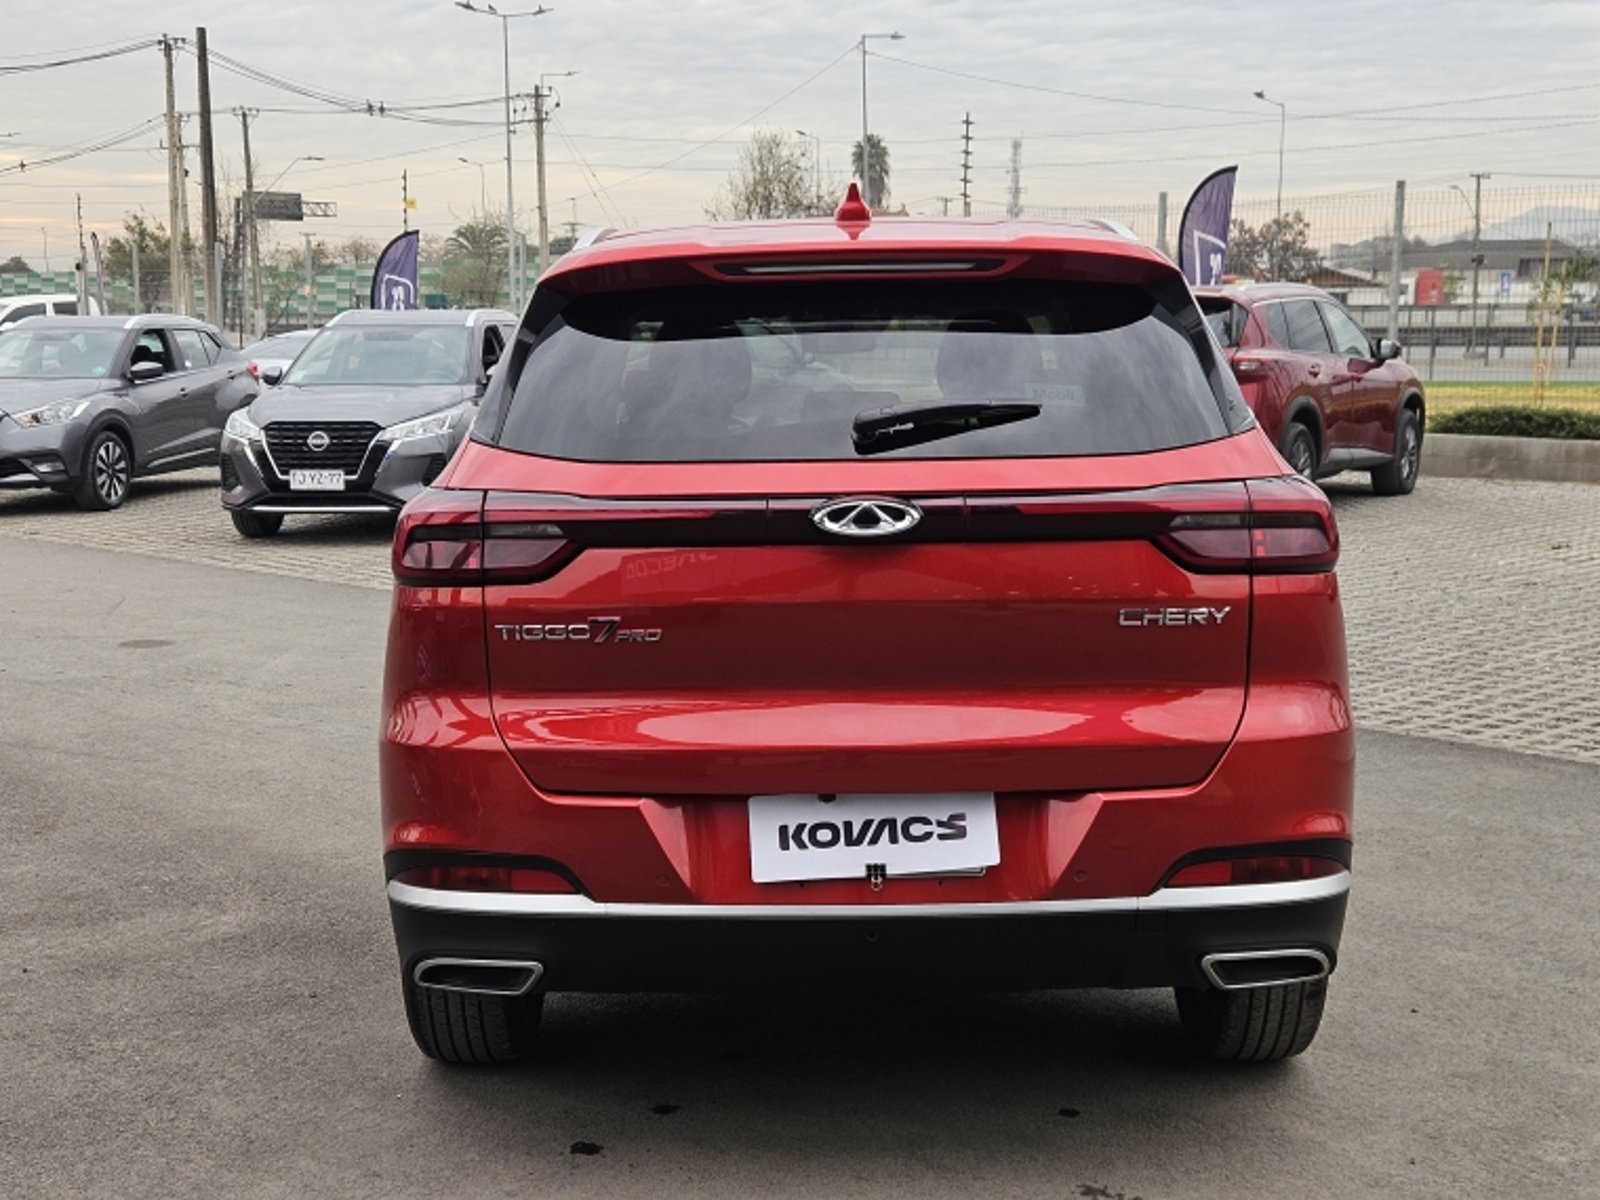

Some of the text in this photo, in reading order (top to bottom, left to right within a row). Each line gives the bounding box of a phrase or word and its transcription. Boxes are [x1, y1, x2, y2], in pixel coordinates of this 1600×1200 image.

[1119, 606, 1231, 626] CHERY
[494, 624, 590, 640] TIGGO
[614, 628, 662, 642] PRO
[778, 812, 967, 851] KOVACS
